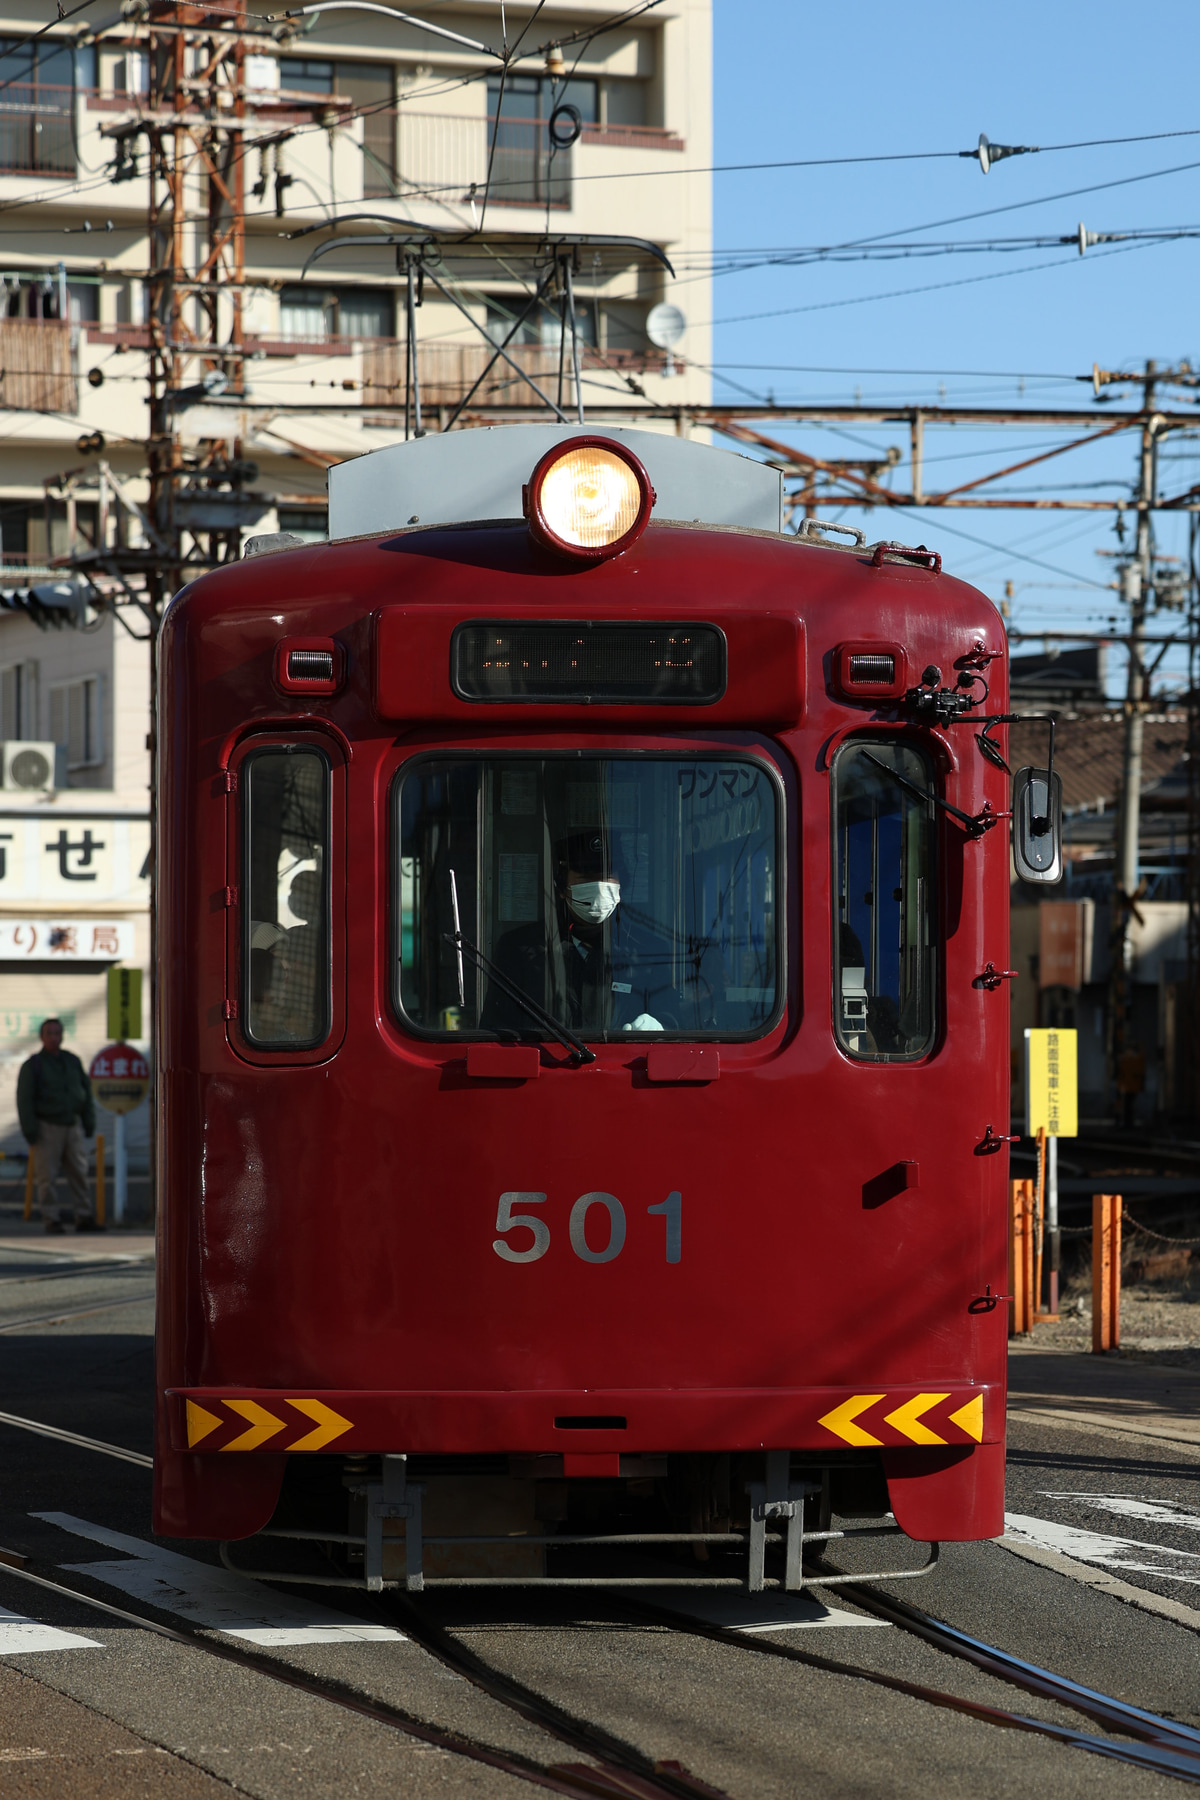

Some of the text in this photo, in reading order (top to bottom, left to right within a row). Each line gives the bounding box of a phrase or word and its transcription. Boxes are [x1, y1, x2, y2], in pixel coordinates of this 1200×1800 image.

[677, 768, 760, 800] ワンマン
[0, 924, 119, 955] り薬局
[93, 1055, 147, 1077] 止まれ
[1046, 1033, 1060, 1133] 路面電車に注意
[492, 1191, 682, 1264] 501
